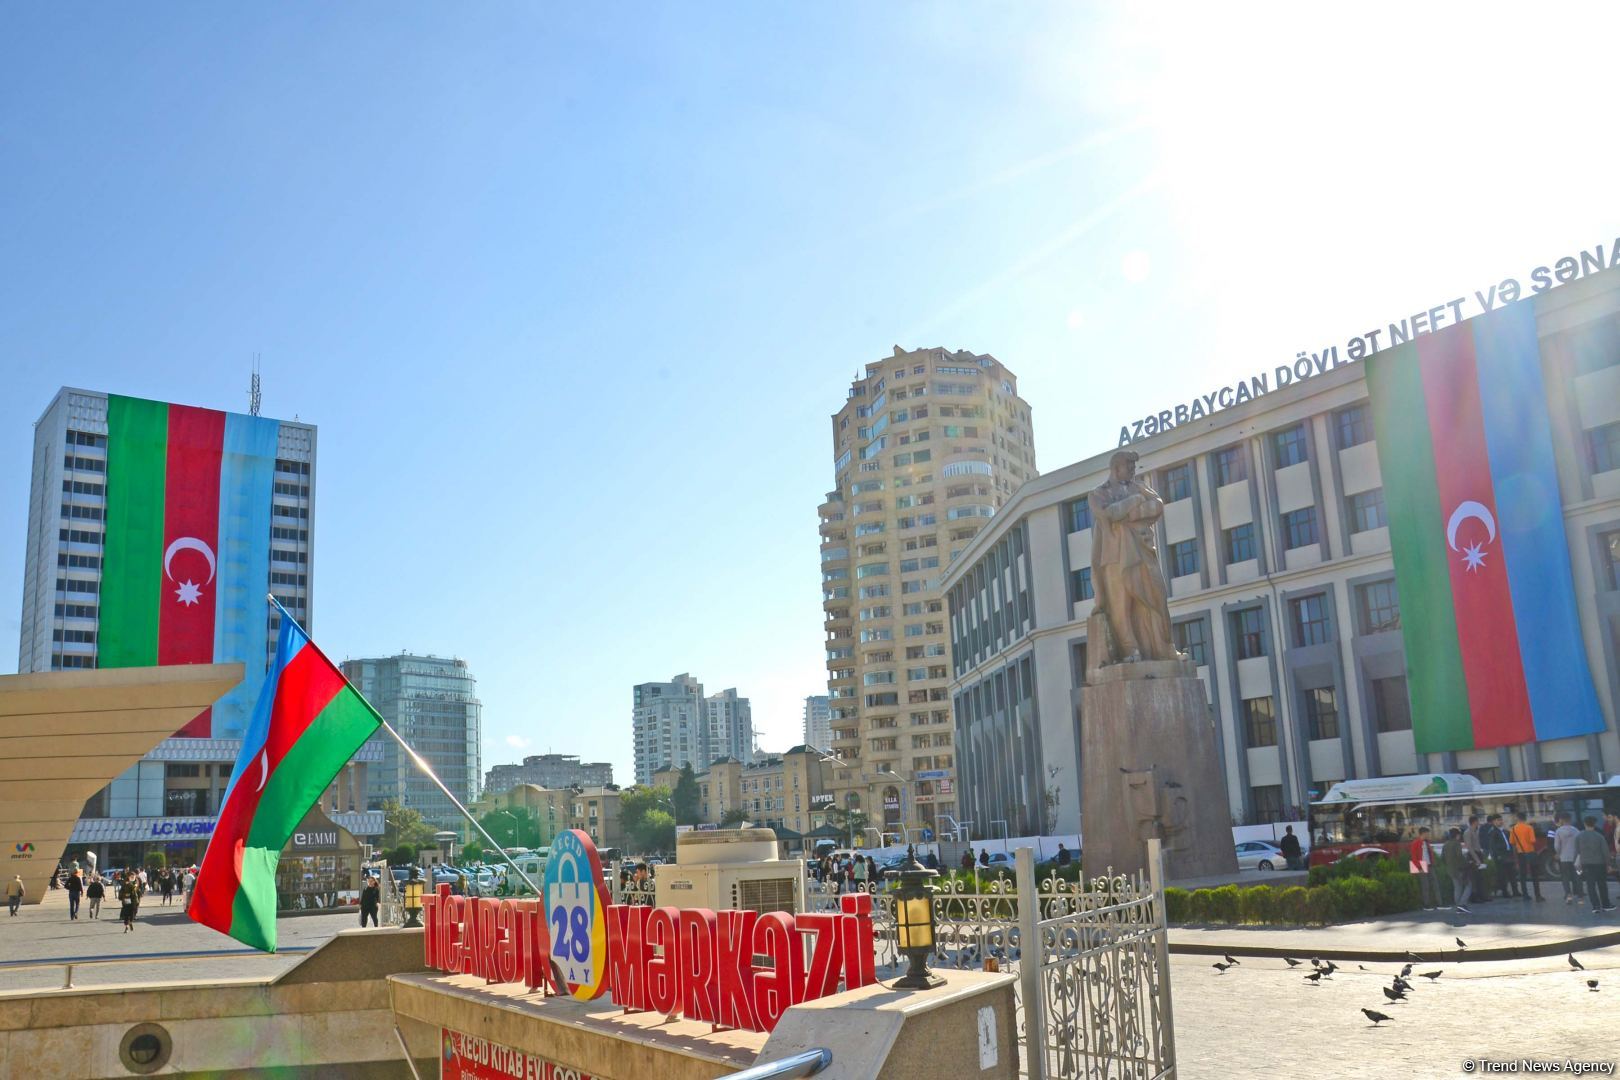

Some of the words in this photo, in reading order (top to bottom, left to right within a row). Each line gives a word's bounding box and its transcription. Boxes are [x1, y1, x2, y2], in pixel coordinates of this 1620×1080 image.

[1118, 373, 1268, 448] AZƏRBAYCAN
[1275, 329, 1382, 390] DÖVLƏT
[1389, 297, 1465, 348] NEFT
[1475, 278, 1521, 313] VƏ
[152, 823, 174, 836] LC
[308, 832, 337, 845] EMMI
[551, 904, 590, 963] 28
[420, 883, 543, 988] TİCARƏT
[606, 892, 876, 1034] MƏRKƏZİ
[568, 967, 591, 983] AY
